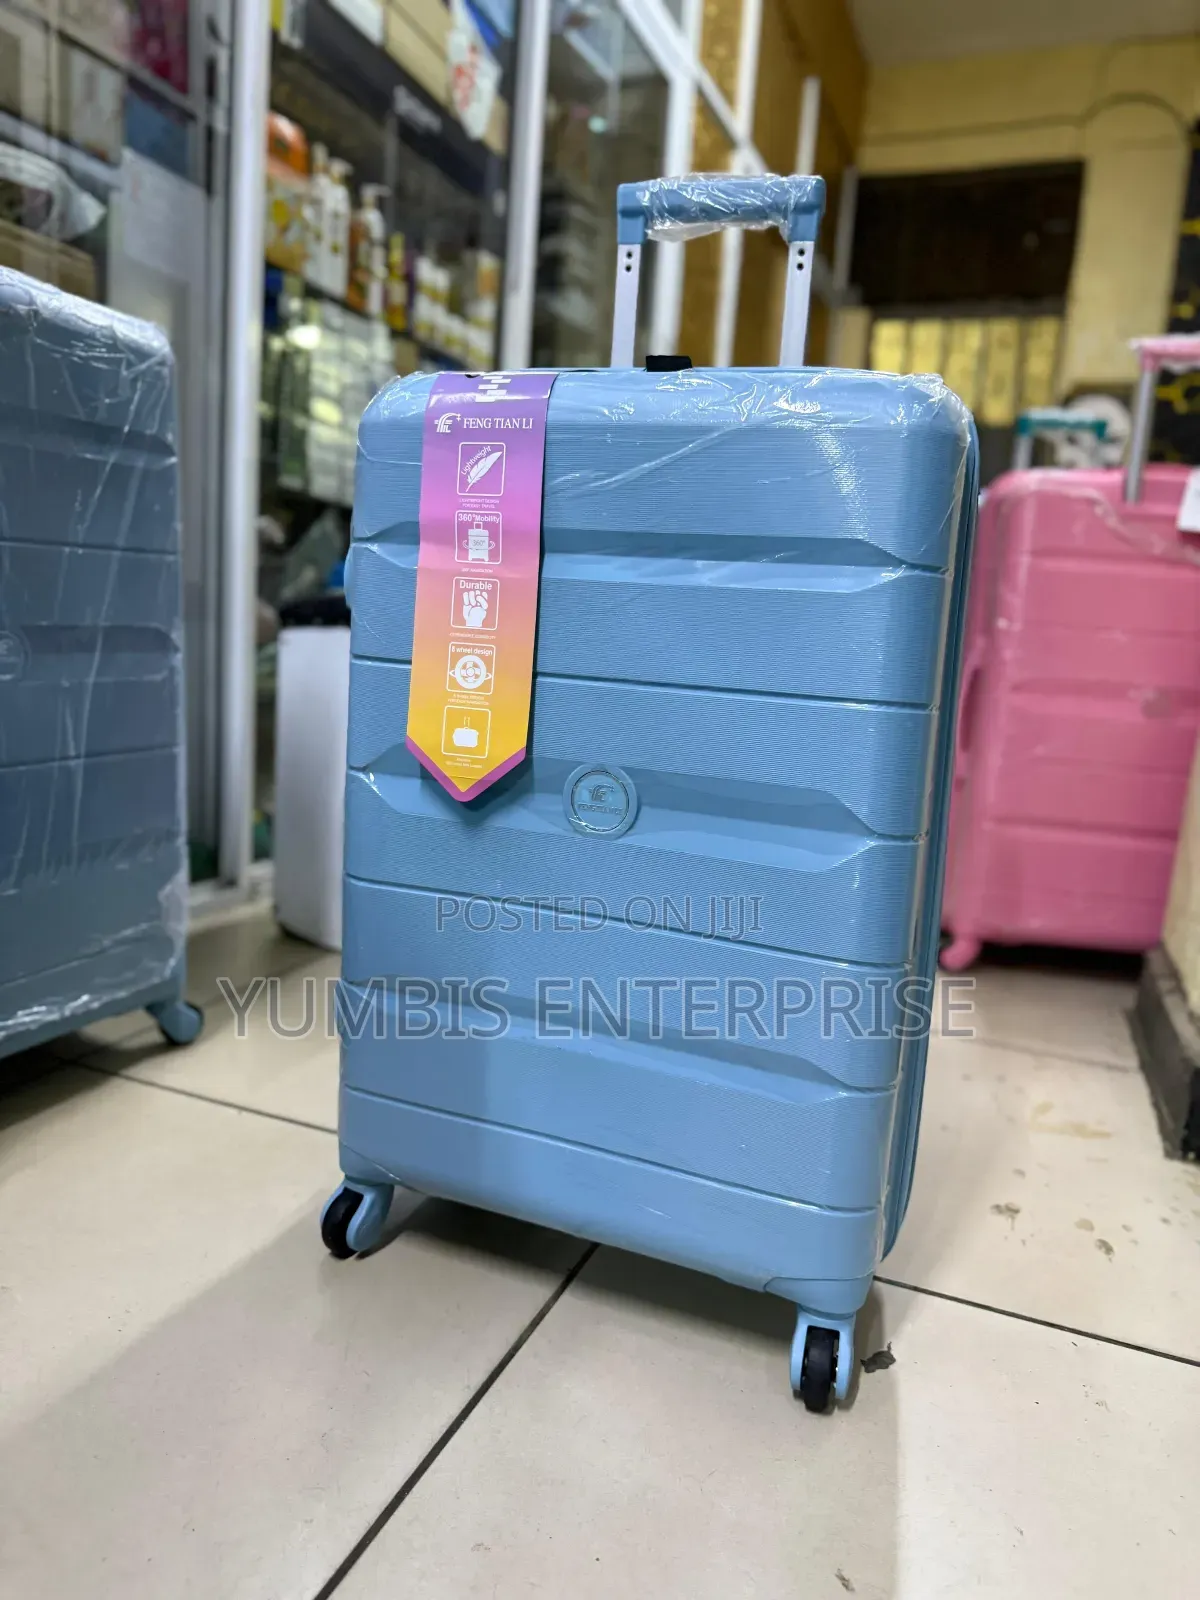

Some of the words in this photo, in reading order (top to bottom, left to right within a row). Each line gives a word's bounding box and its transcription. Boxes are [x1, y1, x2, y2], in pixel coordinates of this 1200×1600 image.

[463, 418, 492, 429] FENG
[494, 418, 520, 429] TIAN
[522, 418, 533, 429] LI
[460, 445, 492, 476] Lightweight
[459, 580, 493, 591] Durable
[456, 647, 473, 655] wheel
[473, 647, 493, 656] design
